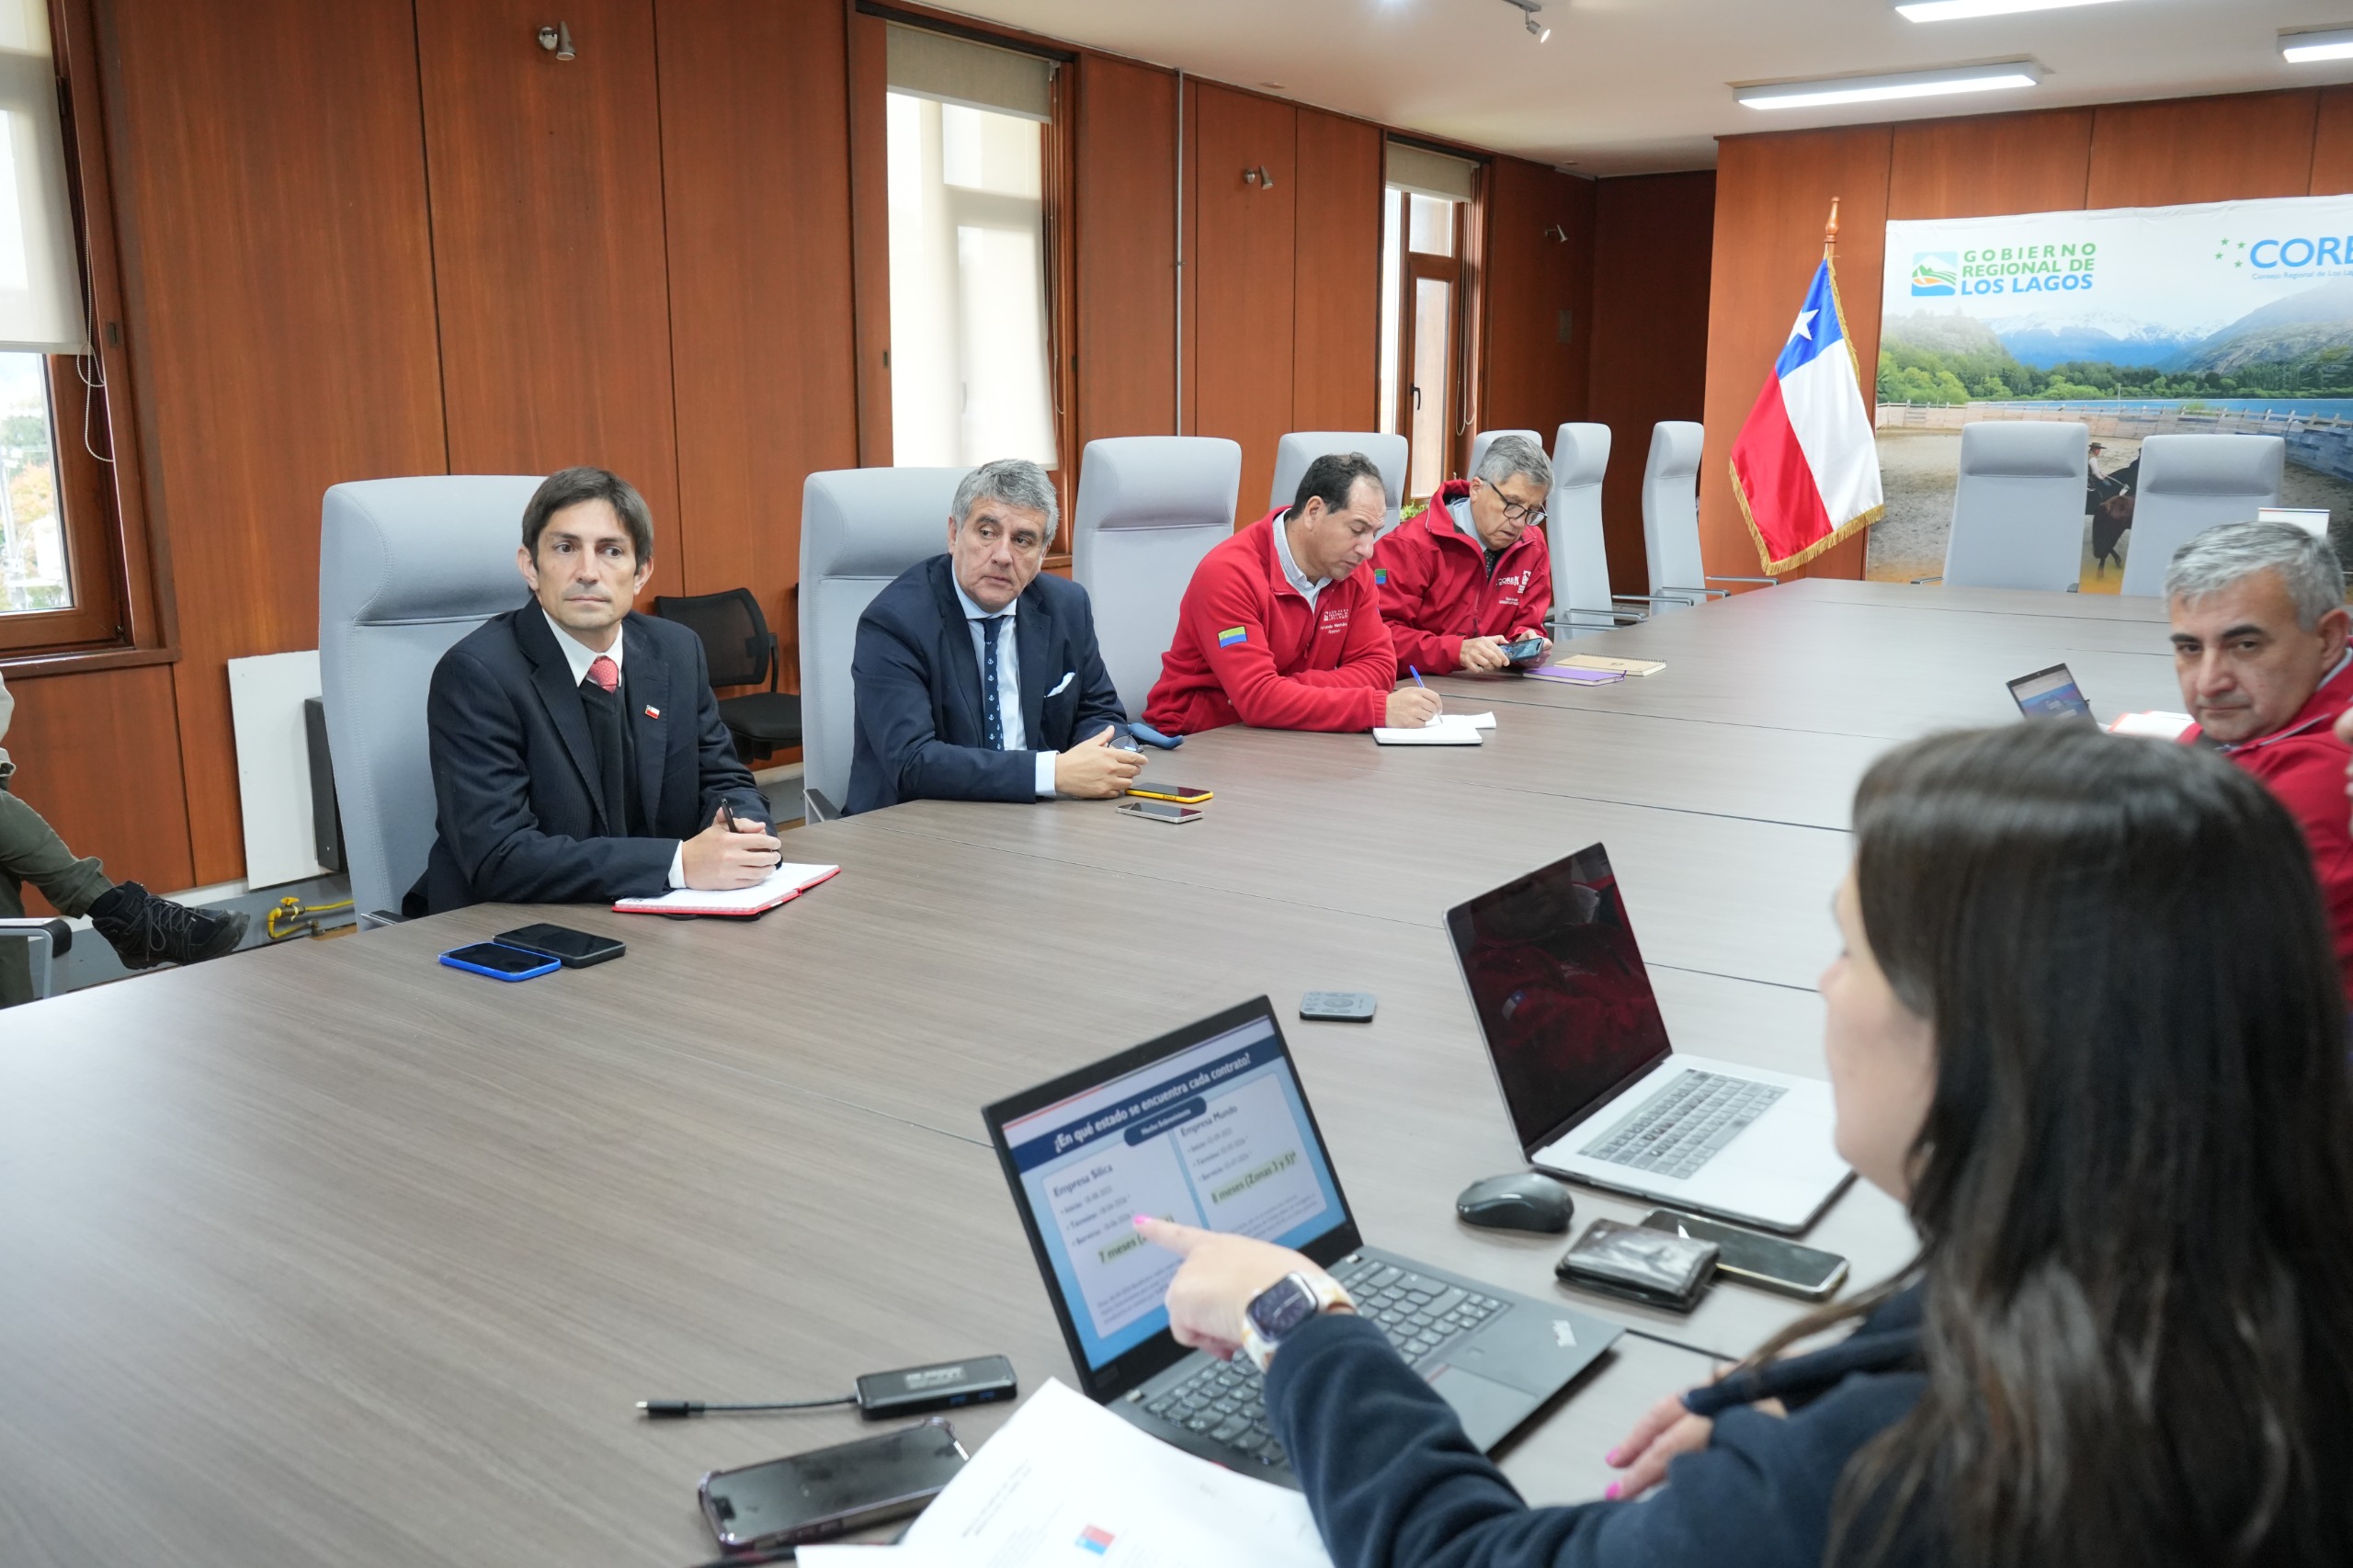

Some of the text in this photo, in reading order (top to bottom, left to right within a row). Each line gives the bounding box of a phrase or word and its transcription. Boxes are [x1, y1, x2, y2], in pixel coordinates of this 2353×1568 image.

[1963, 243, 2097, 262] GOBIERNO
[1962, 258, 2095, 278] REGIONAL DE
[2284, 271, 2314, 279] Regional
[1961, 274, 2094, 295] LOS LAGOS
[1054, 1052, 1251, 1153] ¿En qué estado se encuentra cada contrato?
[1180, 1106, 1237, 1137] Empresa Mundo
[1053, 1176, 1091, 1198] Empresa
[1219, 1182, 1245, 1199] meses
[1108, 1239, 1136, 1258] meses
